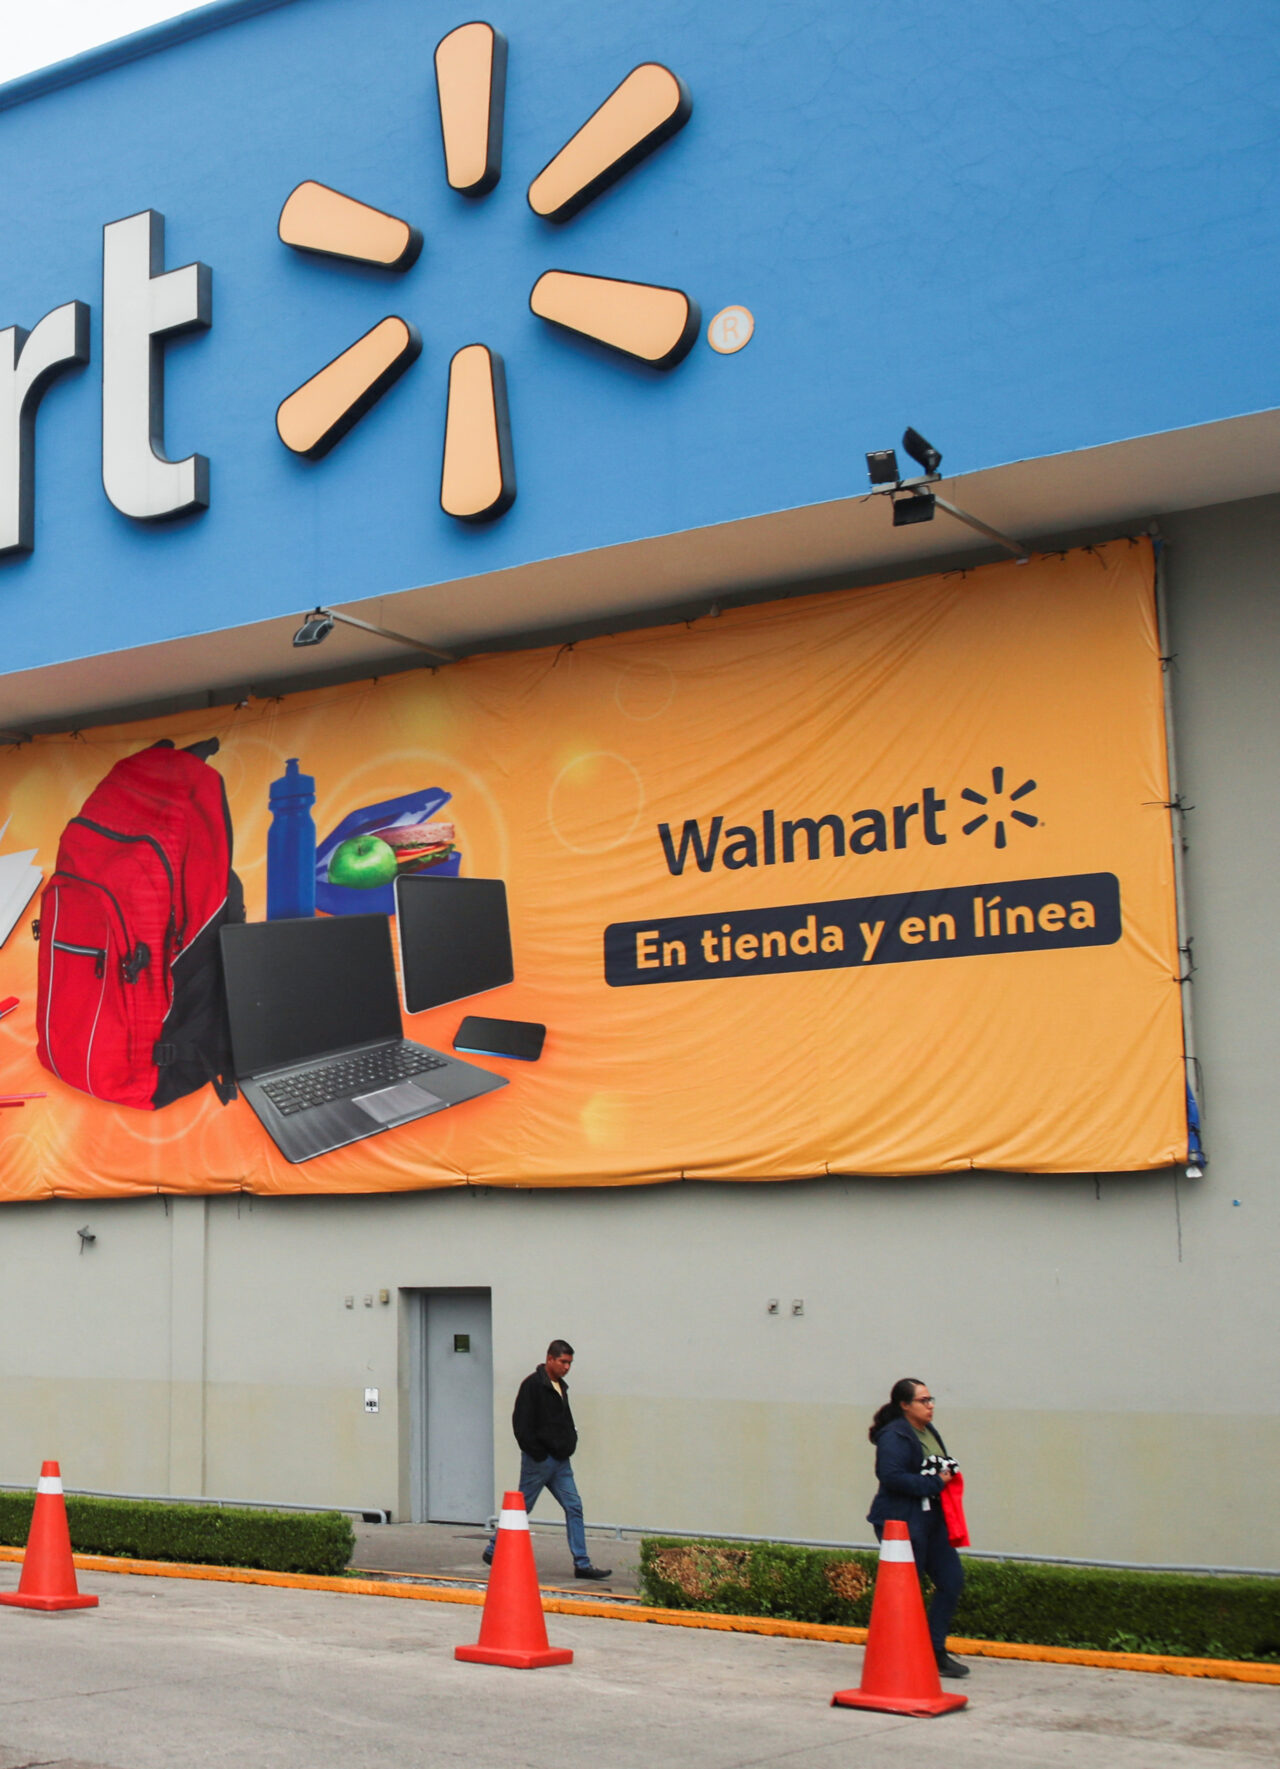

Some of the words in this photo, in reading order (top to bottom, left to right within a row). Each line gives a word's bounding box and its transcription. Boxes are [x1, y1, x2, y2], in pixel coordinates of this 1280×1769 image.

[657, 787, 947, 876] Walmart
[635, 930, 687, 969] En
[701, 916, 844, 963] tienda
[859, 921, 885, 961] y
[899, 906, 956, 944] en
[973, 896, 1096, 937] línea
